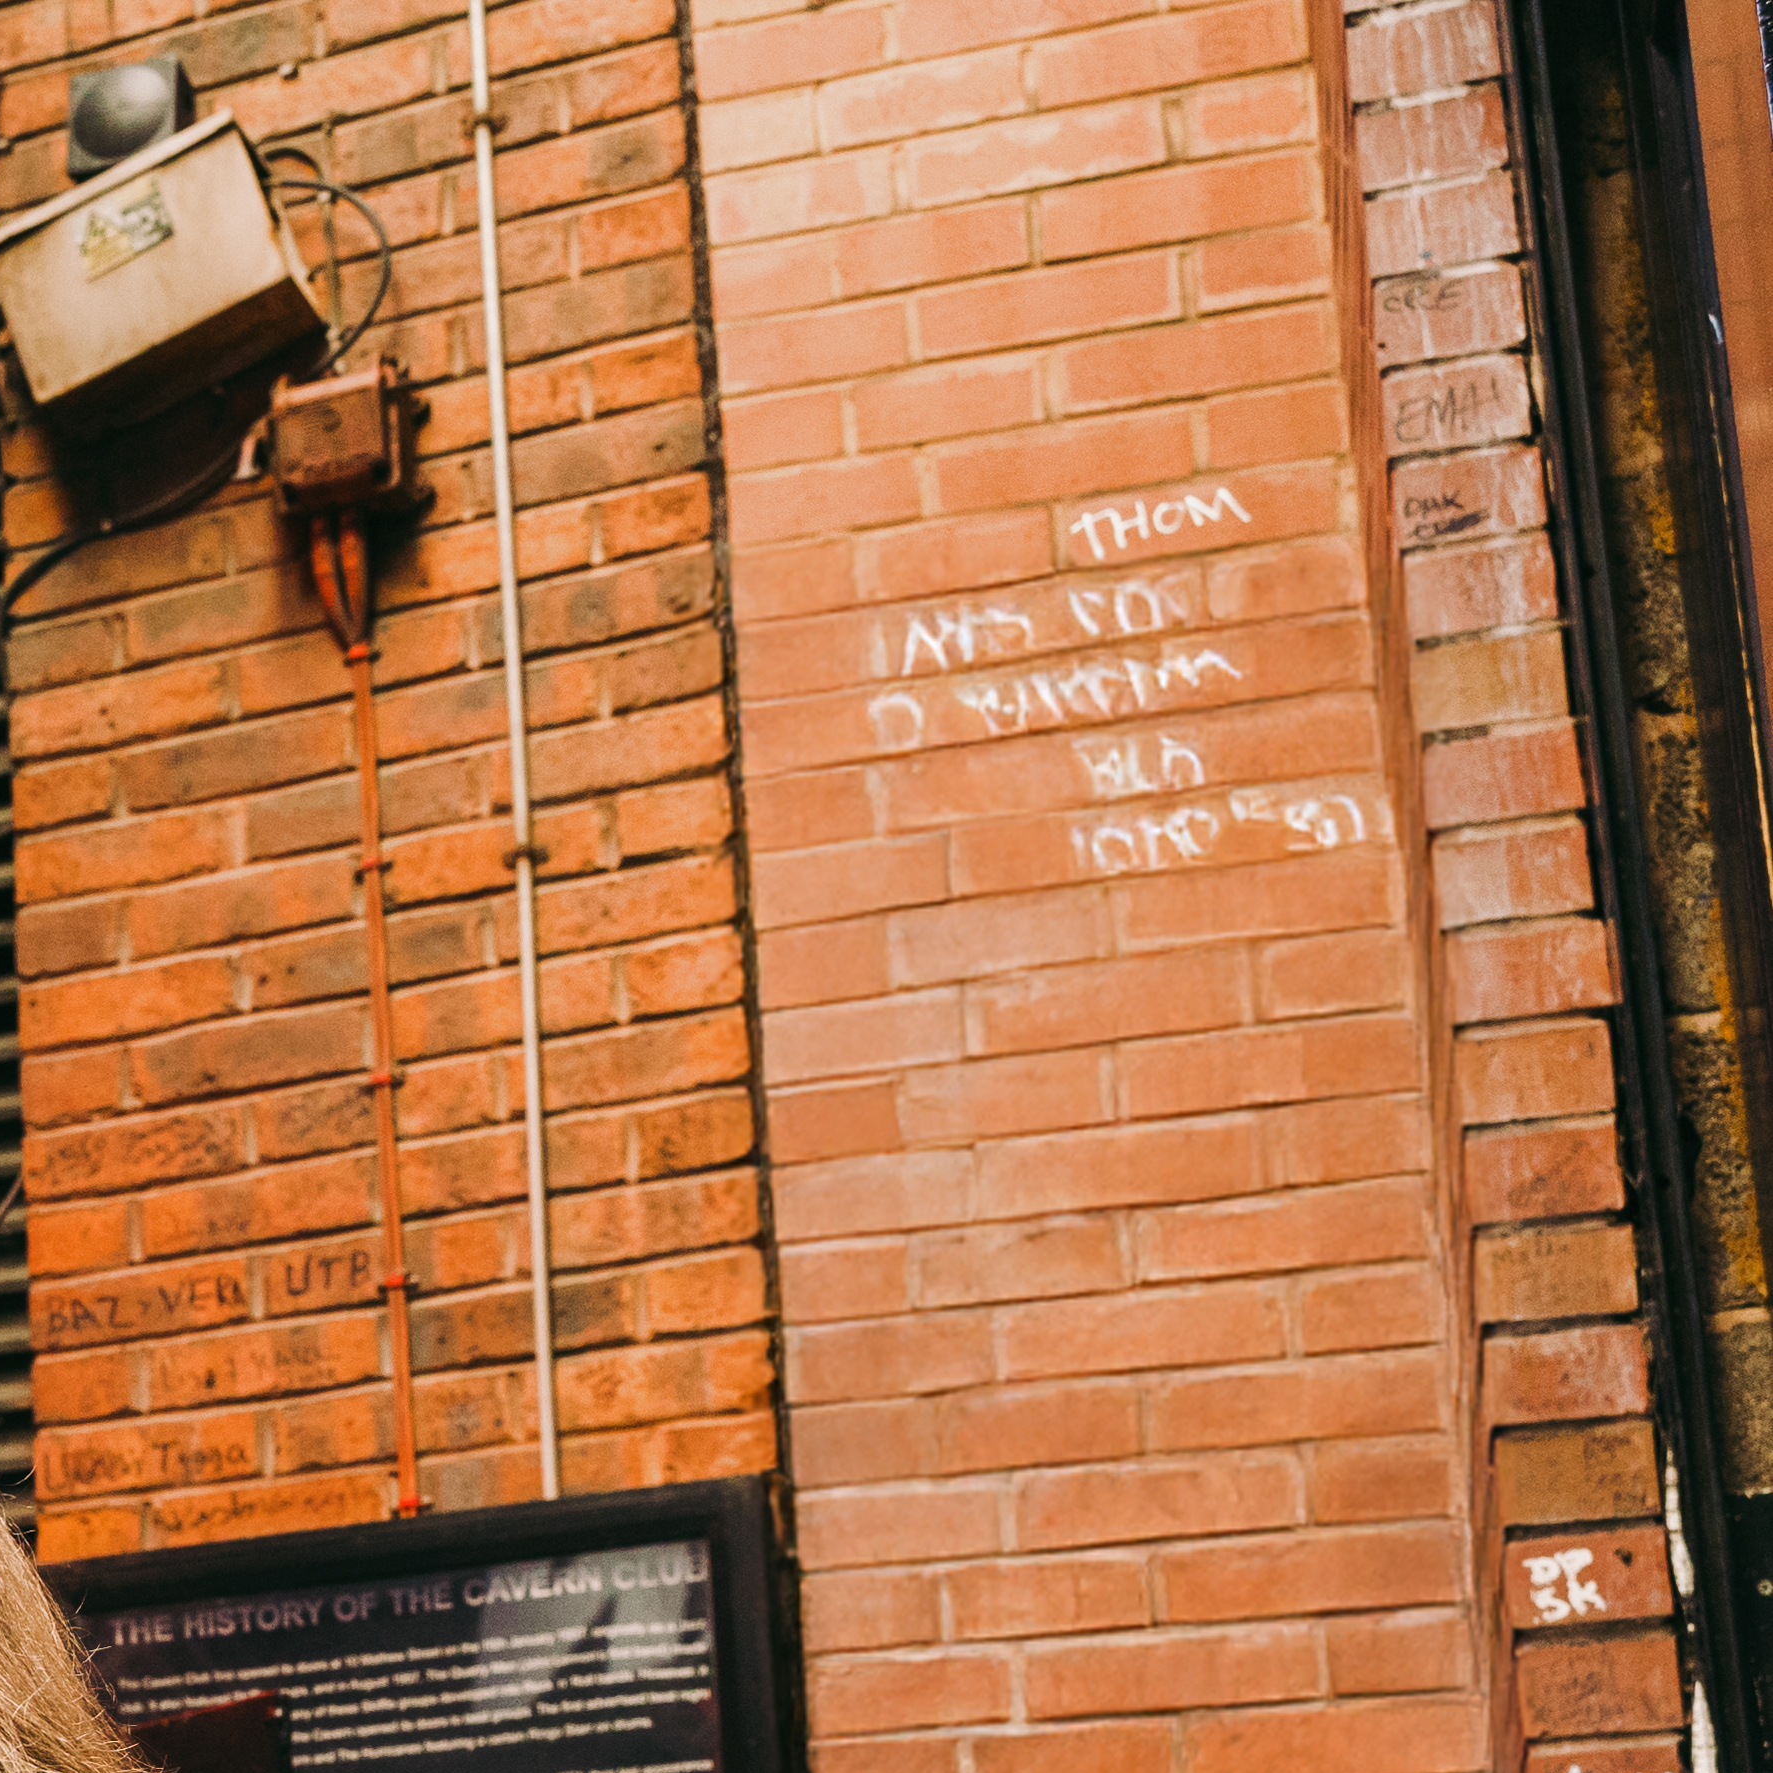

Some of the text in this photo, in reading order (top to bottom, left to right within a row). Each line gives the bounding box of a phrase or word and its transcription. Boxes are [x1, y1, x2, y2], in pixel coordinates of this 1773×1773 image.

[1069, 486, 1252, 561] THOM
[112, 1615, 174, 1648] THE
[183, 1600, 322, 1641] HISTORY
[333, 1591, 379, 1623] OF
[387, 1582, 455, 1618] THE
[462, 1562, 603, 1607] CAVERN
